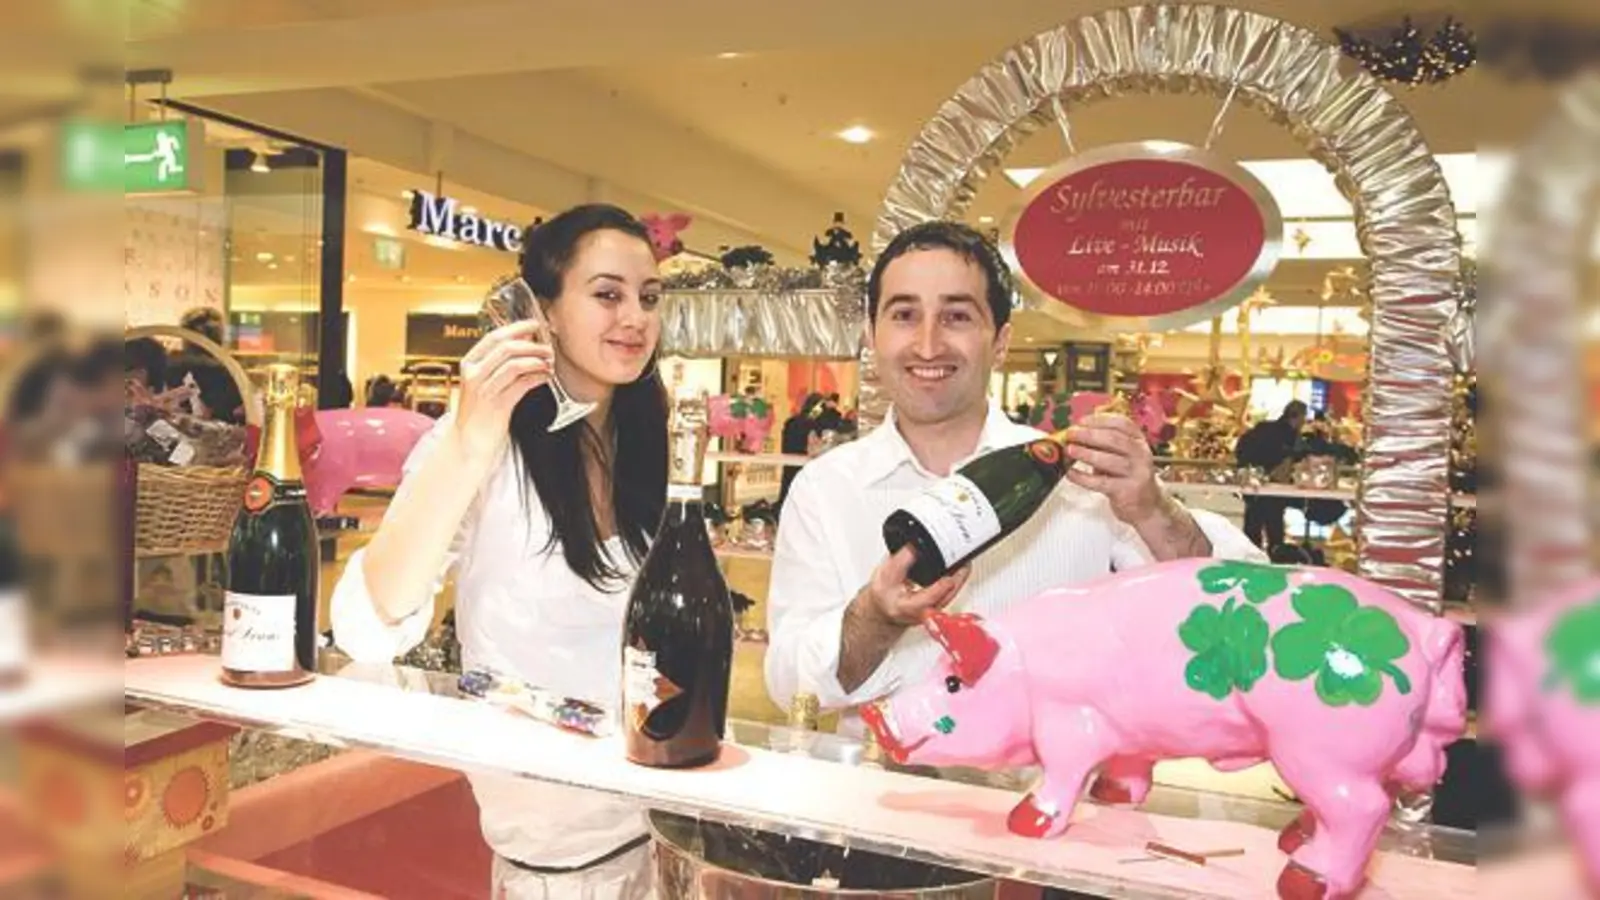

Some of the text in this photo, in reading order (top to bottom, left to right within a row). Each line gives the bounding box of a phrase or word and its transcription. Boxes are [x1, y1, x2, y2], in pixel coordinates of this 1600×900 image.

[1050, 177, 1226, 222] Sylvesterbar
[1067, 234, 1116, 255] Live
[1133, 231, 1204, 257] Musik
